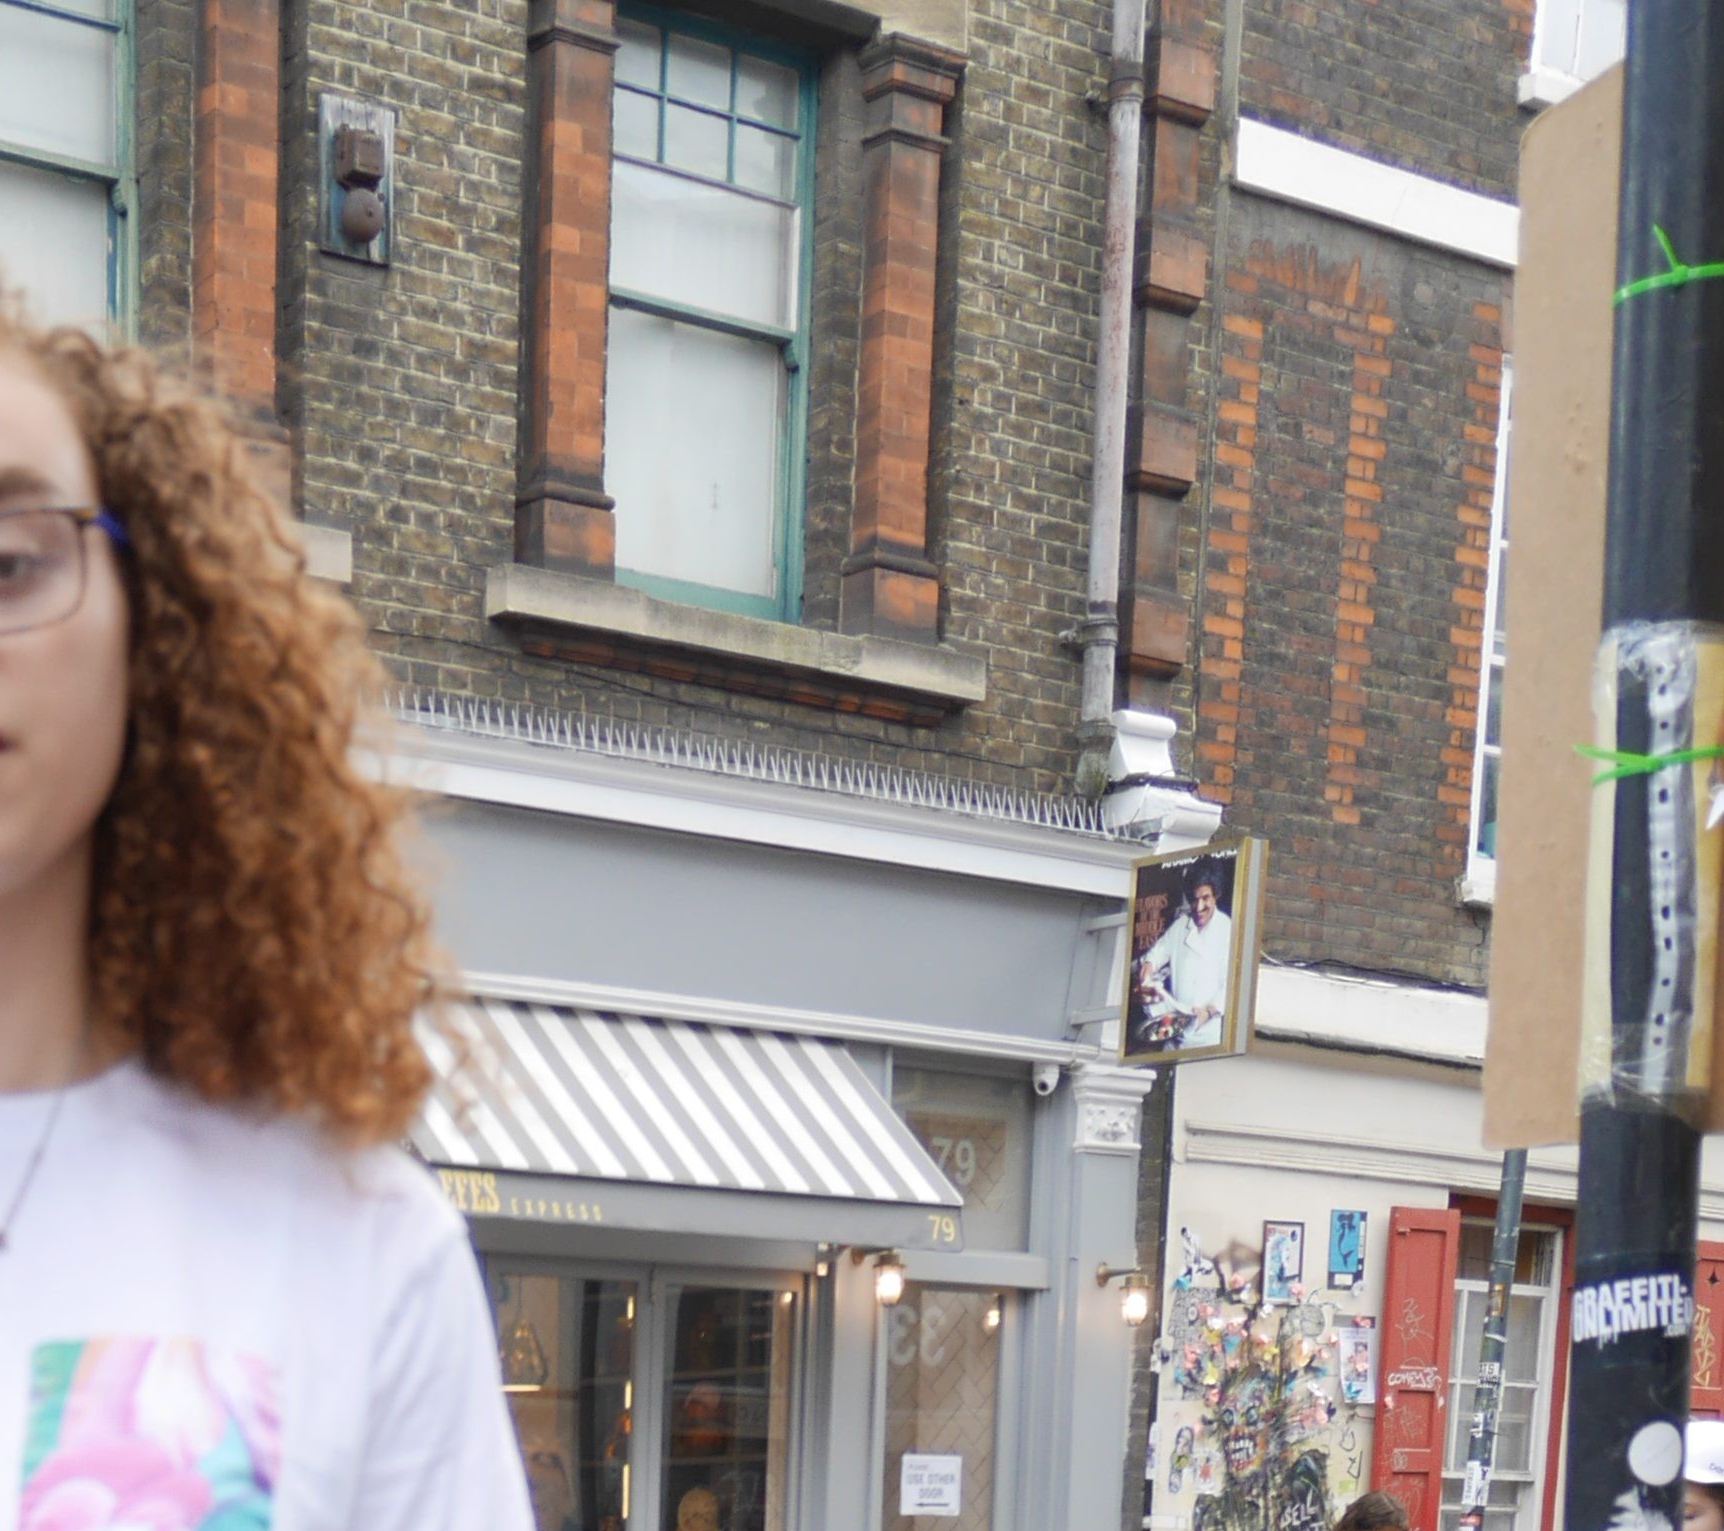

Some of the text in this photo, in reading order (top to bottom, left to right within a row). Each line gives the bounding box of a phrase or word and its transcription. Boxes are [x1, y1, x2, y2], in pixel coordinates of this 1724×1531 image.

[932, 1136, 975, 1185] 79
[438, 1168, 602, 1222] EFES EXPRESS
[928, 1215, 956, 1242] 79
